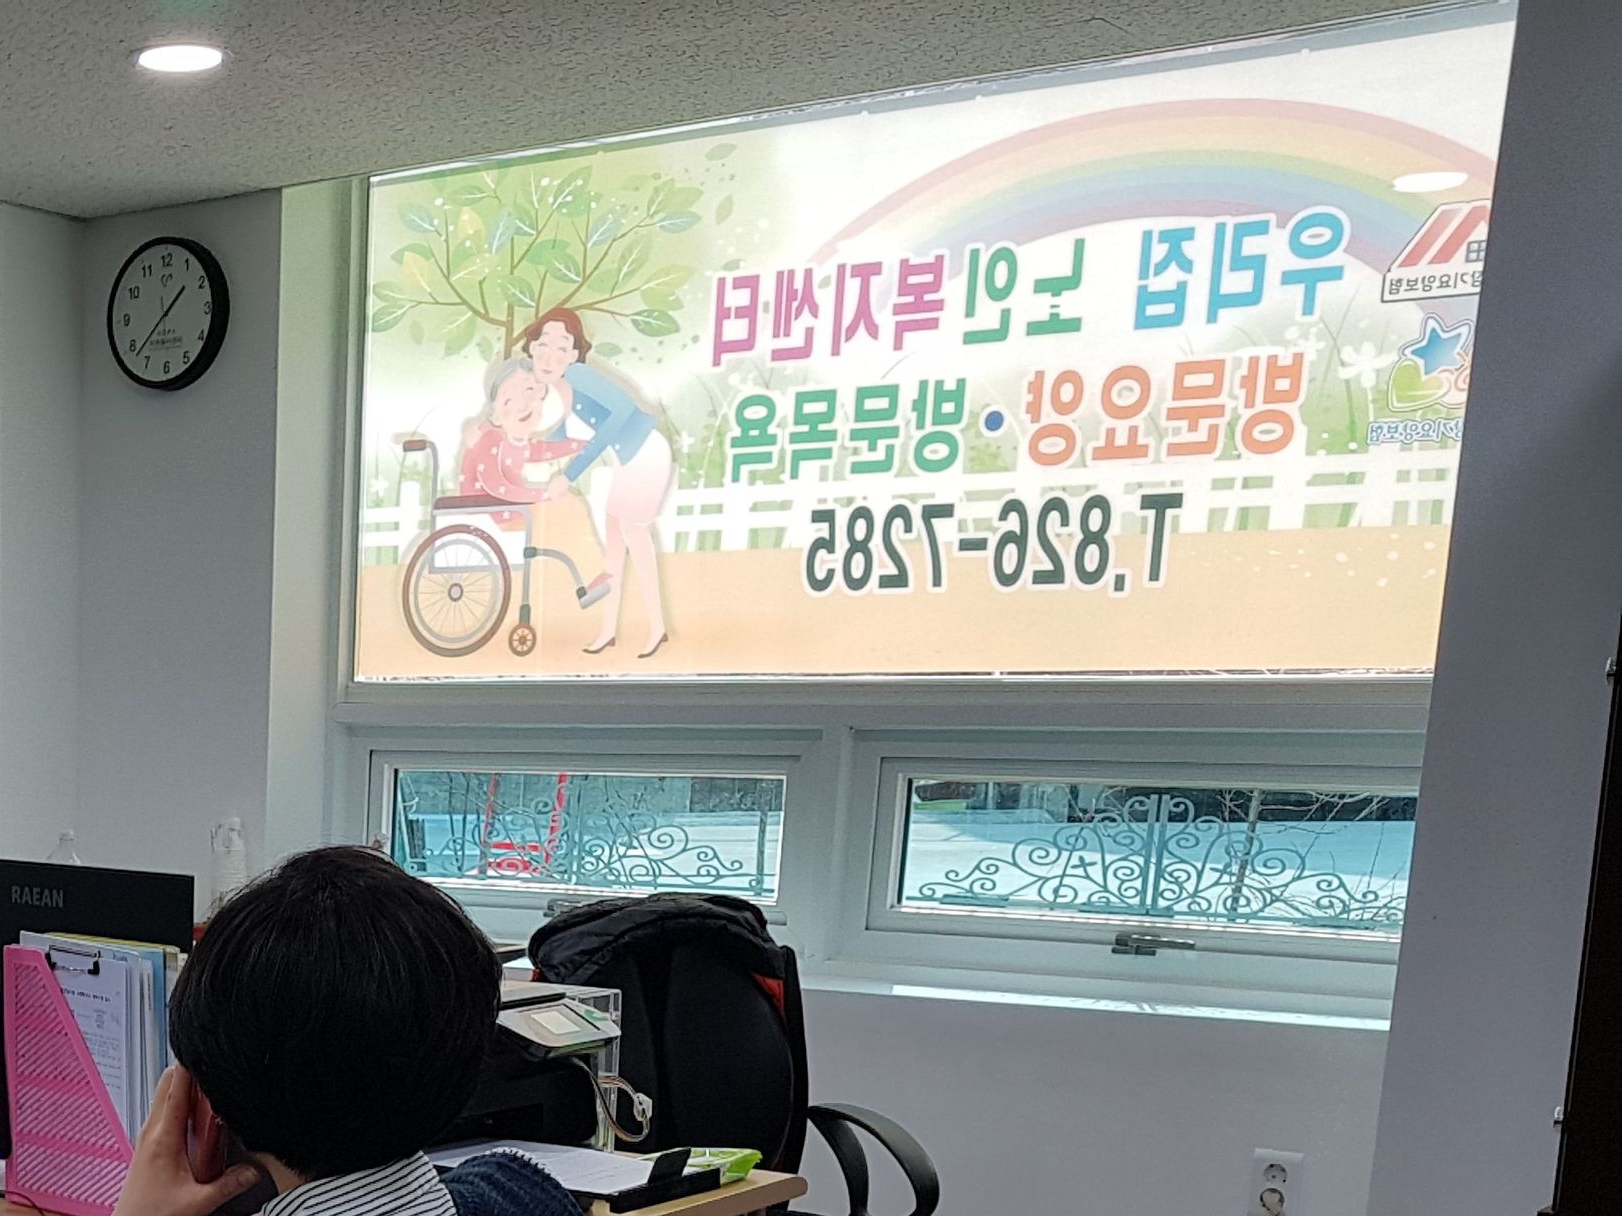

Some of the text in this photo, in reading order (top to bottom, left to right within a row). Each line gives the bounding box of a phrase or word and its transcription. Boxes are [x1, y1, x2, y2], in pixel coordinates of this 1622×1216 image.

[161, 252, 173, 268] 12
[185, 258, 189, 271] 1
[142, 264, 152, 278] 11
[198, 275, 206, 289] 2
[128, 286, 140, 300] 10
[203, 301, 211, 315] 3
[123, 313, 130, 327] 9
[198, 329, 204, 342] 4
[129, 339, 136, 352] 8
[144, 356, 151, 369] 7
[183, 351, 190, 365] 5
[163, 361, 170, 374] 6
[11, 885, 63, 908] RAEAN
